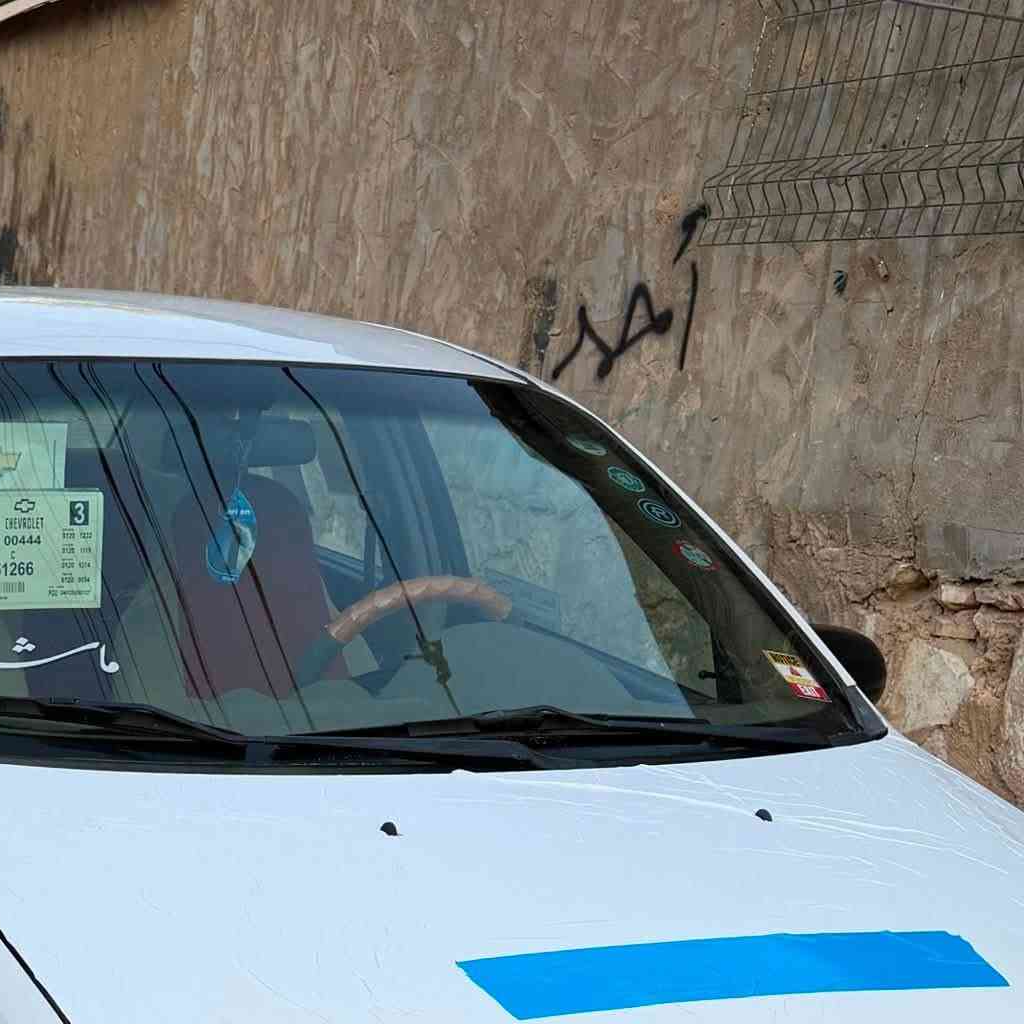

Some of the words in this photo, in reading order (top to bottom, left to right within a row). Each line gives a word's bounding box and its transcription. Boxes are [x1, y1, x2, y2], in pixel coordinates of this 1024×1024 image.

[74, 502, 85, 524] 3
[5, 516, 44, 530] CHEVROLET
[4, 535, 42, 546] 00444
